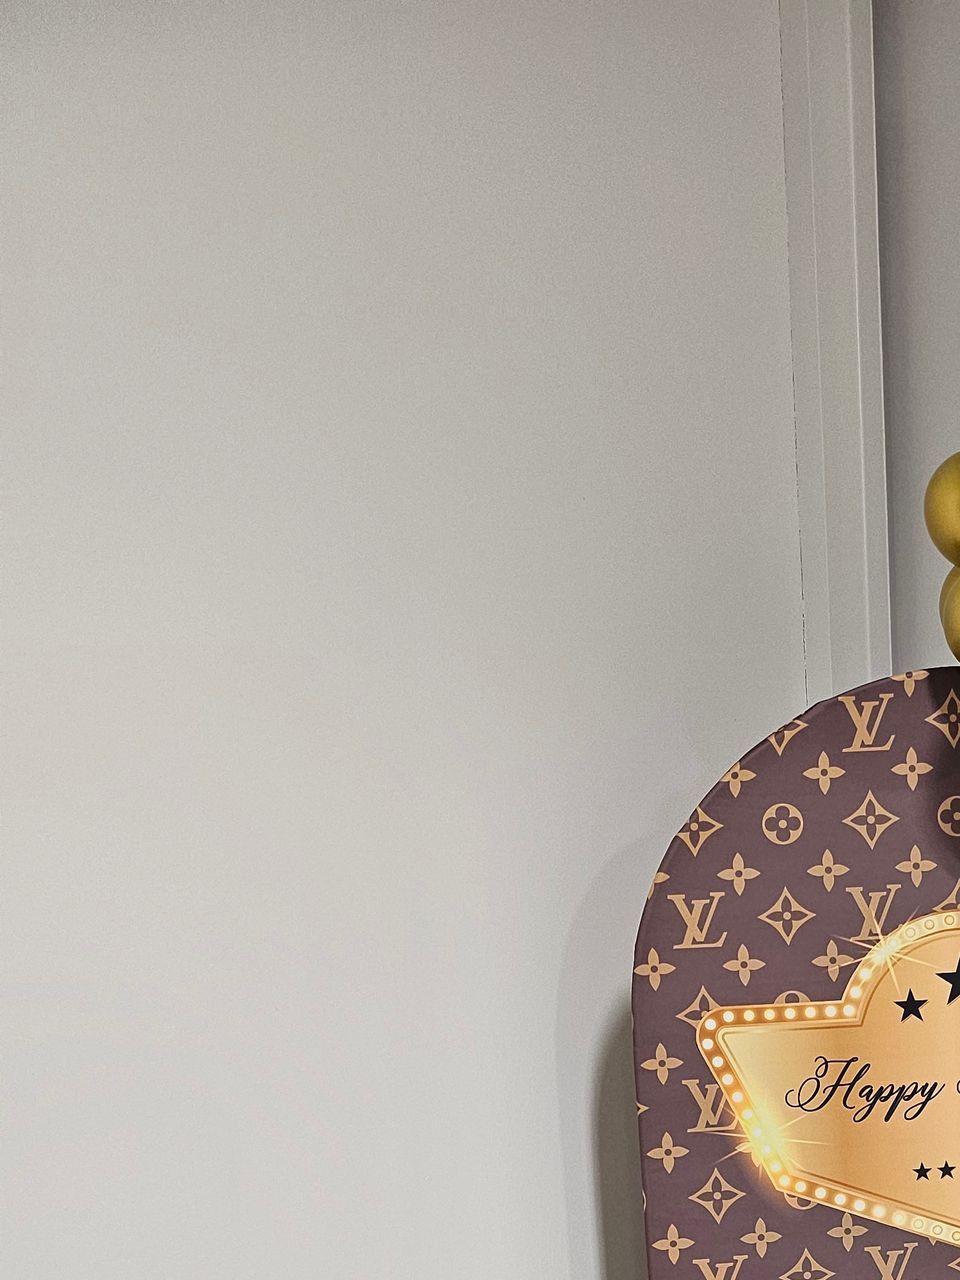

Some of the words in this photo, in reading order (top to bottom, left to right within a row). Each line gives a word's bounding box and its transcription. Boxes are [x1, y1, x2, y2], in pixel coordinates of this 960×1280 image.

[837, 693, 896, 753] LV
[667, 891, 728, 949] LV
[785, 1055, 946, 1123] Happy
